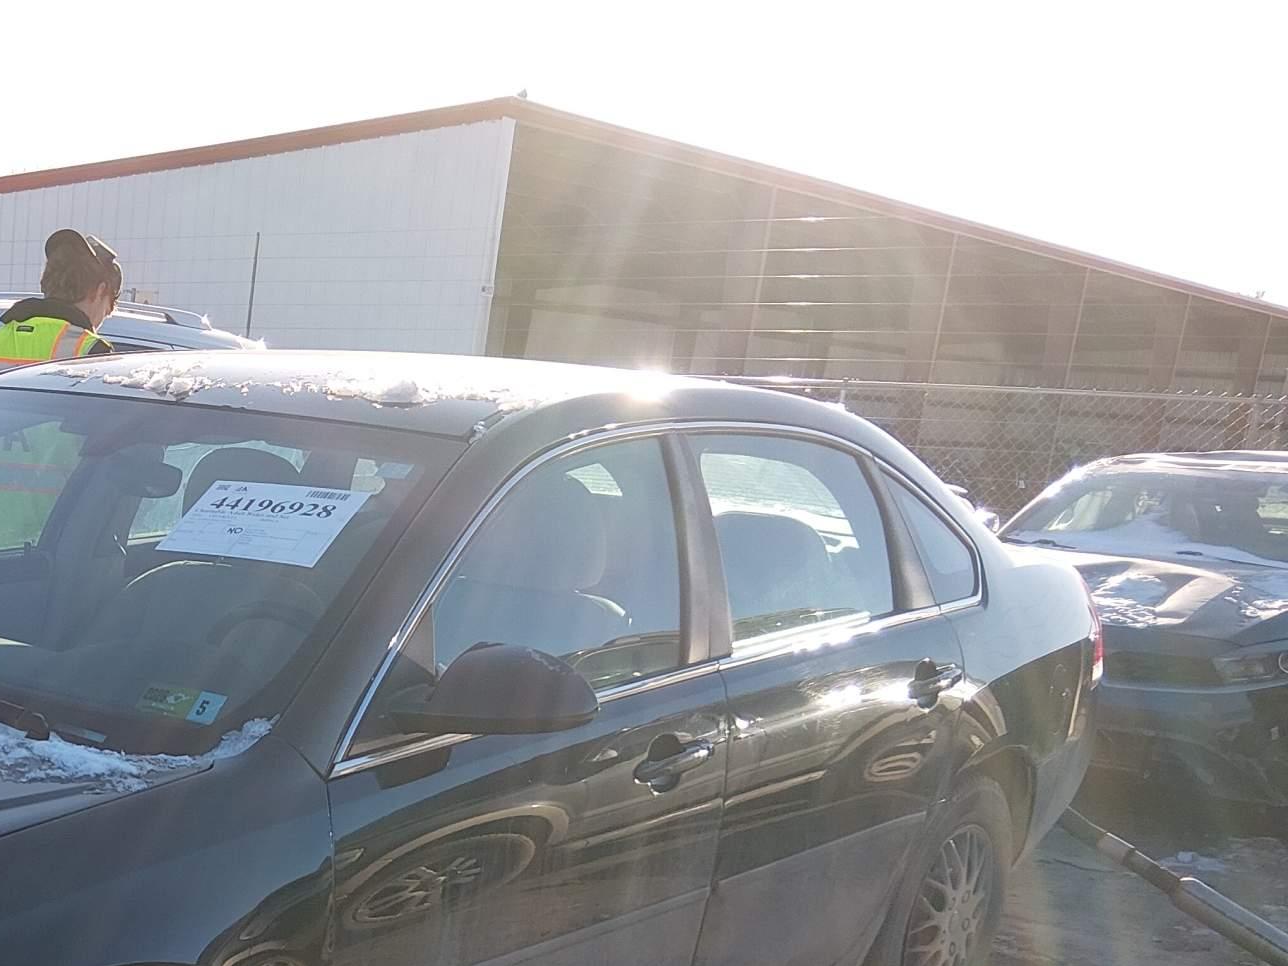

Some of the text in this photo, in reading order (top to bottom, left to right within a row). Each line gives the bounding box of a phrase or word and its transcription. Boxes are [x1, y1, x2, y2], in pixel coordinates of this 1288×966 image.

[210, 496, 337, 519] 44196928
[226, 527, 244, 535] NO
[196, 700, 210, 716] 5
